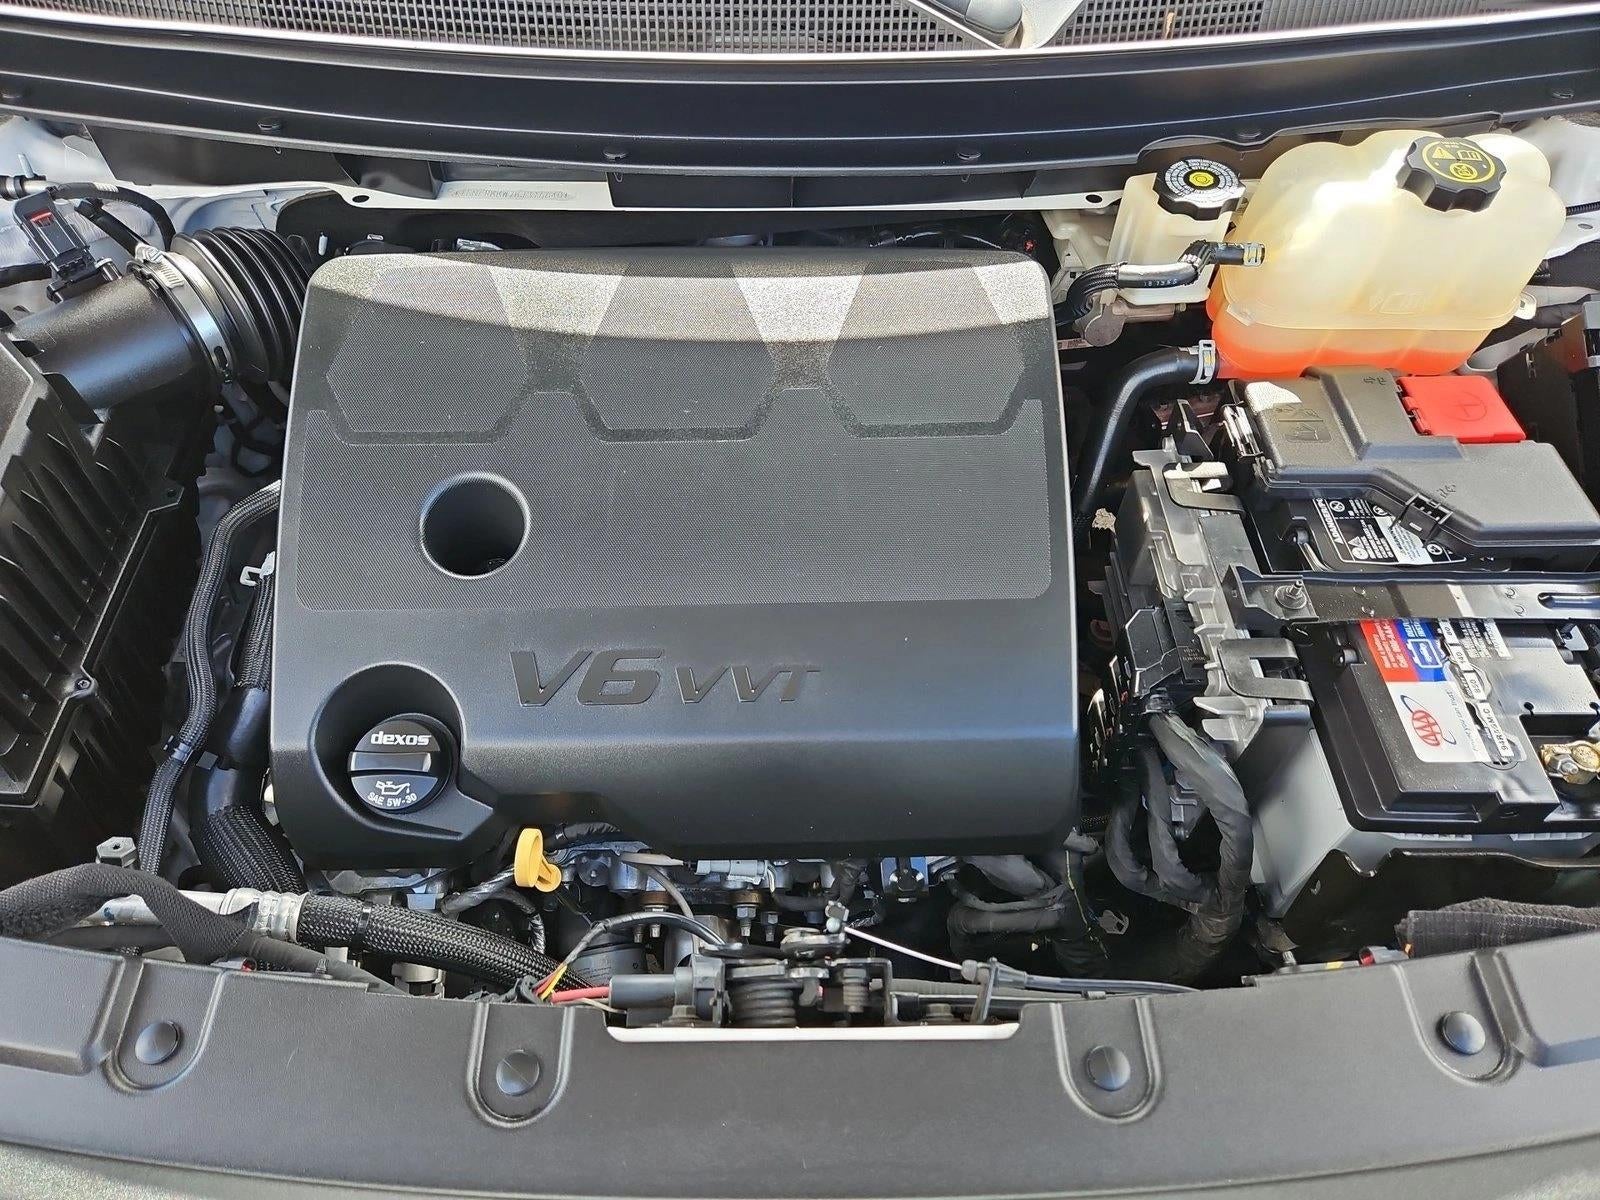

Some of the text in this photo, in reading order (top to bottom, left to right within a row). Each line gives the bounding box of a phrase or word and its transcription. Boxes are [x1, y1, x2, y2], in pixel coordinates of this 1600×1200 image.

[509, 650, 821, 706] V6 VVT
[370, 731, 432, 745] dexos
[1412, 711, 1441, 746] AAA
[367, 792, 418, 807] SAE 5W-30
